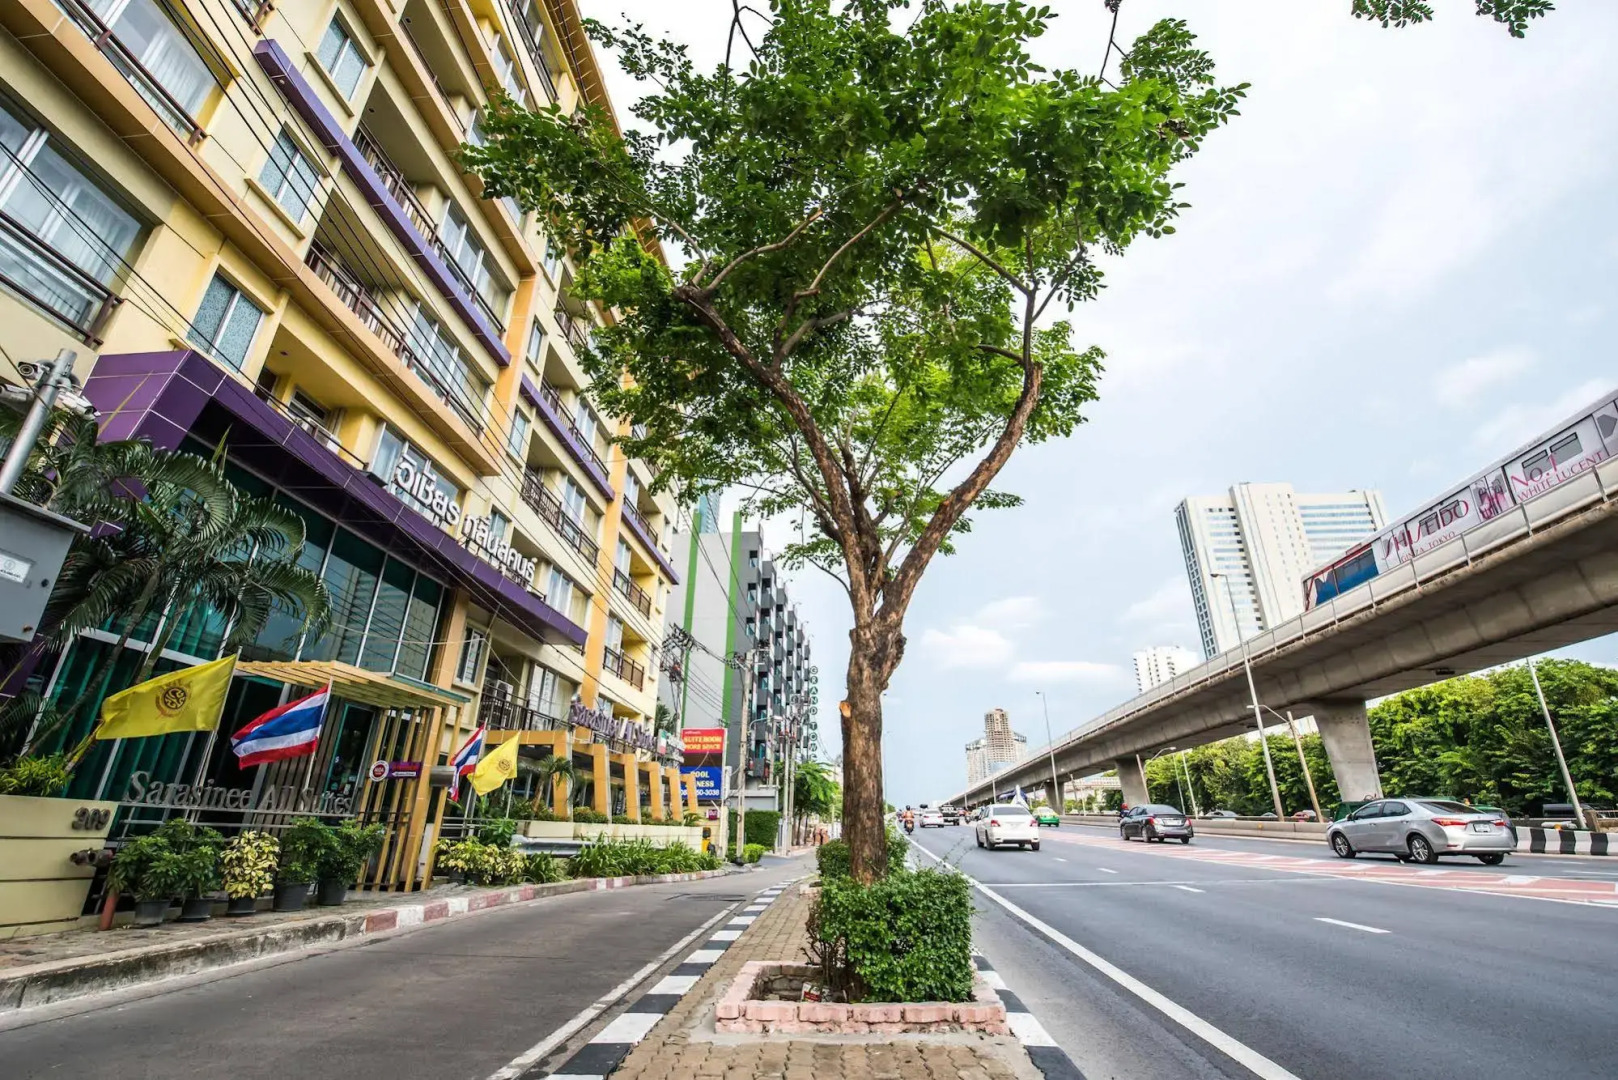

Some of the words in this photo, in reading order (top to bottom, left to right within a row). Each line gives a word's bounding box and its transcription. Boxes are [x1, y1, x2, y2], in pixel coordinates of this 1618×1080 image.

[1517, 477, 1552, 501] WHITE
[1556, 451, 1604, 483] LUCENT
[1381, 500, 1469, 560] SHISEIDO
[1429, 531, 1456, 550] TOKYO
[810, 666, 818, 715] GRAND
[123, 770, 252, 809] Sarasinee
[257, 784, 295, 813] All
[300, 786, 353, 815] Suites
